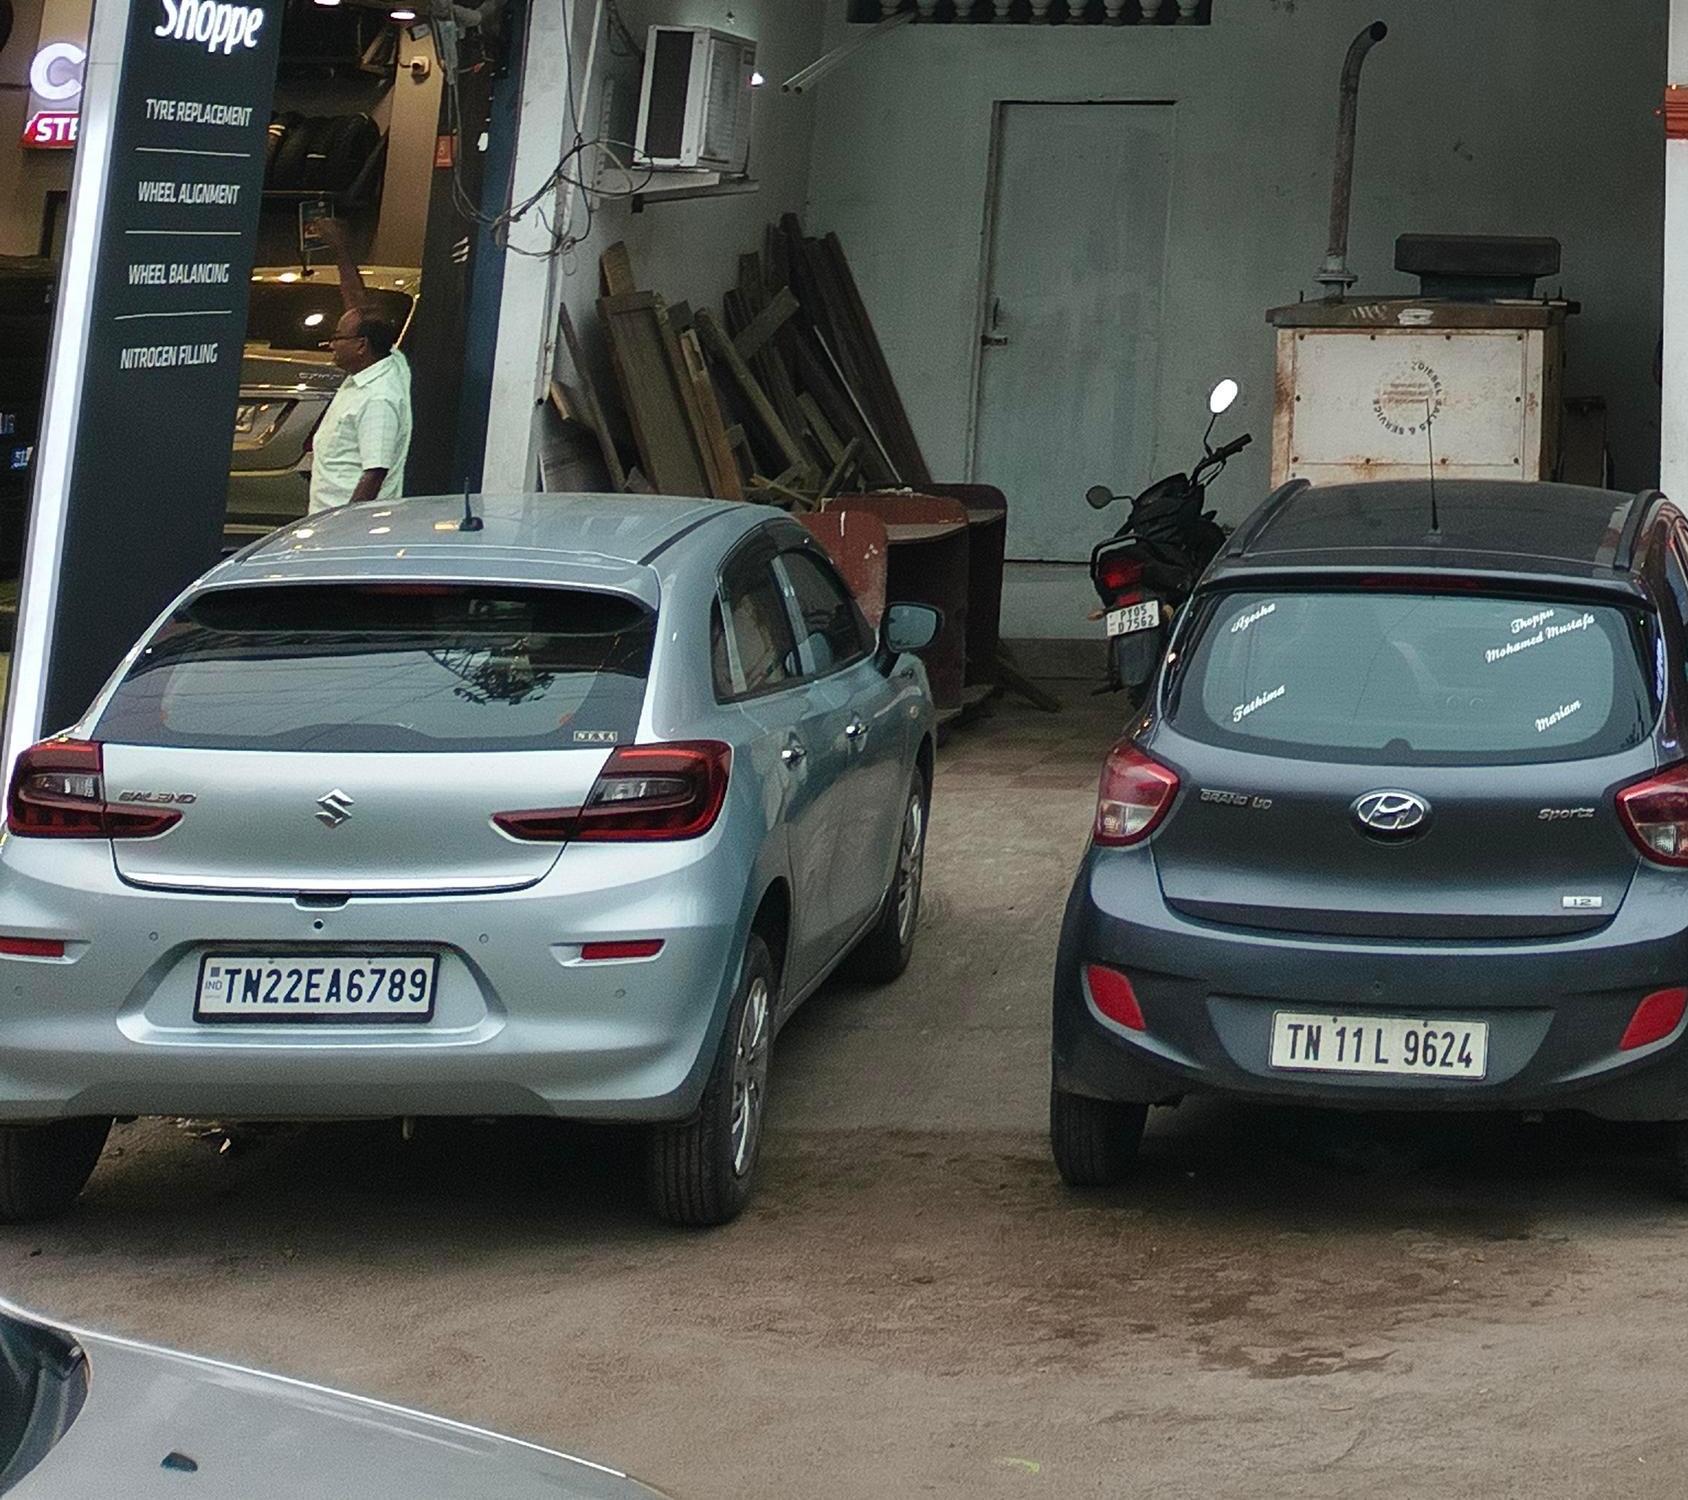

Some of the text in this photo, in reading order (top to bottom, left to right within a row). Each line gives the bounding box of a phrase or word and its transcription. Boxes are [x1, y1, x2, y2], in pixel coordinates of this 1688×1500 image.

[146, 98, 252, 127] TYRE REPLACEMENT
[138, 180, 240, 205] WHEEL ALIGNMENT
[128, 262, 230, 286] WHEEL BALANCING
[120, 342, 219, 370] NITROGEN FILLING
[1484, 631, 1545, 664] Mohamed
[1200, 789, 1248, 806] GRAND
[223, 967, 428, 1005] TN22EA6789
[1287, 1023, 1473, 1069] TN 11 L 9624
